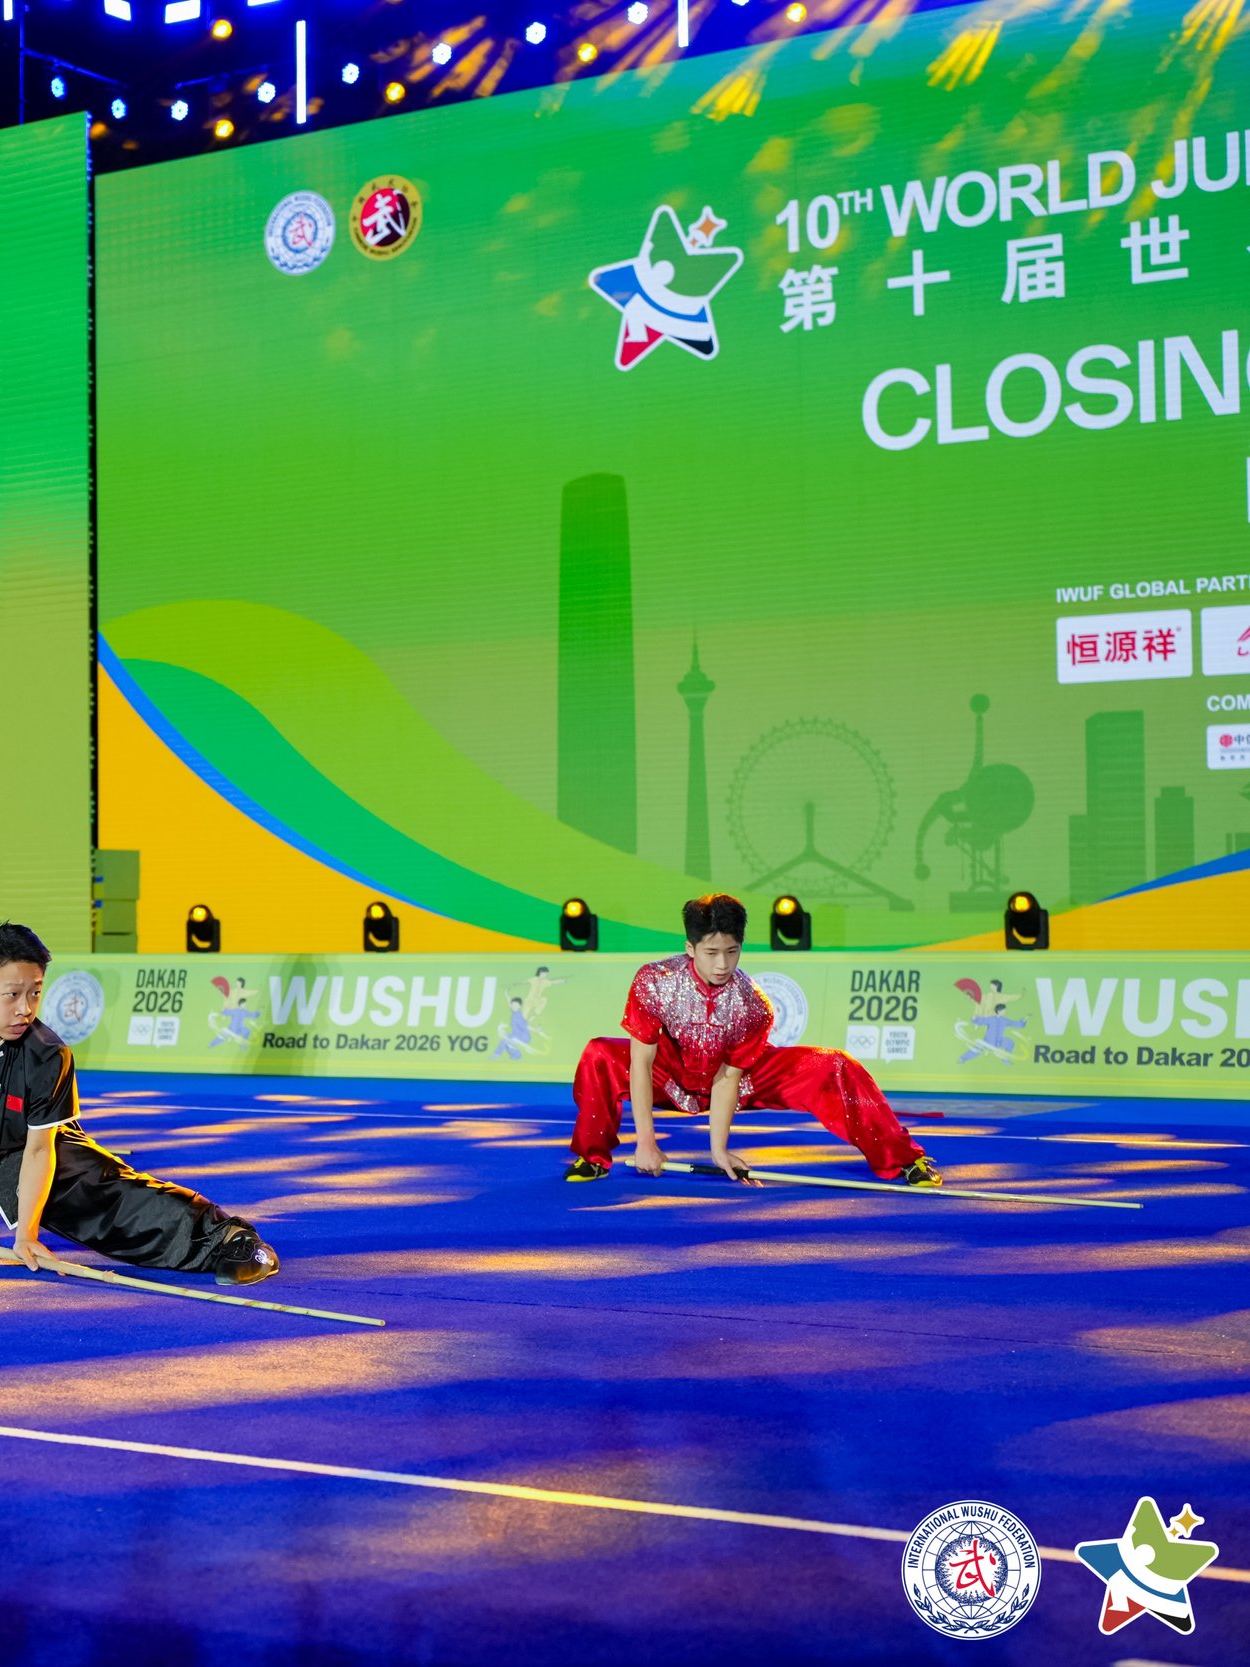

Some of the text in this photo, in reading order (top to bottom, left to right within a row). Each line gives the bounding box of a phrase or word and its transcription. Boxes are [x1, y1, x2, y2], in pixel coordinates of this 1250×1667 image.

[775, 128, 1250, 253] 10TH WORLD JU
[777, 214, 1250, 334] 第十届世
[861, 329, 1250, 452] CLOSIN
[1056, 584, 1104, 604] IWUF
[1109, 578, 1191, 600] GLOBAL
[1066, 627, 1177, 667] 恒源祥
[135, 968, 188, 989] DAKAR
[850, 969, 921, 993] DAKAR
[132, 990, 184, 1014] 2026
[268, 974, 498, 1028] WUSHU
[848, 995, 919, 1023] 2026
[262, 1031, 490, 1053] Road to Dakar 2026 YOG
[1034, 1044, 1097, 1065] Road
[1103, 1046, 1129, 1065] to
[1136, 1045, 1215, 1068] Dakar
